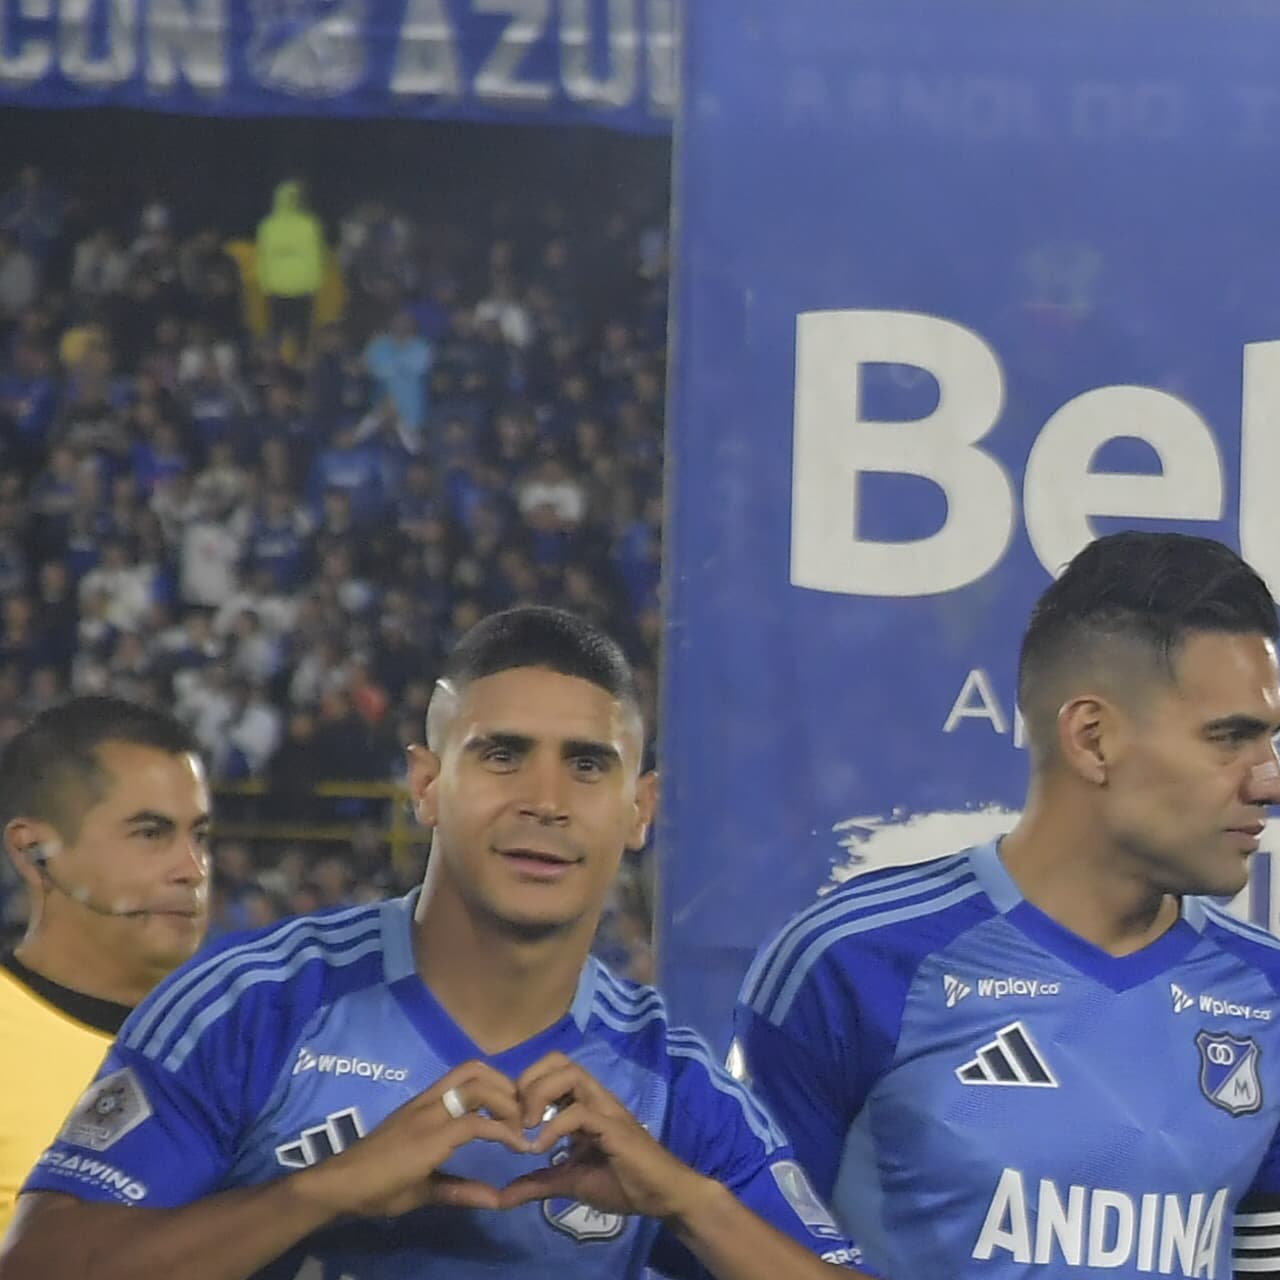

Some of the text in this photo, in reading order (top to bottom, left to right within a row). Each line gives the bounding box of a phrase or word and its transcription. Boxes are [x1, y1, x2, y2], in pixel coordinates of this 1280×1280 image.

[978, 978, 1061, 997] Wplay.co
[1199, 995, 1271, 1021] Wplay.co
[317, 1054, 408, 1081] Wplay.co
[971, 1167, 1229, 1280] ANDINA
